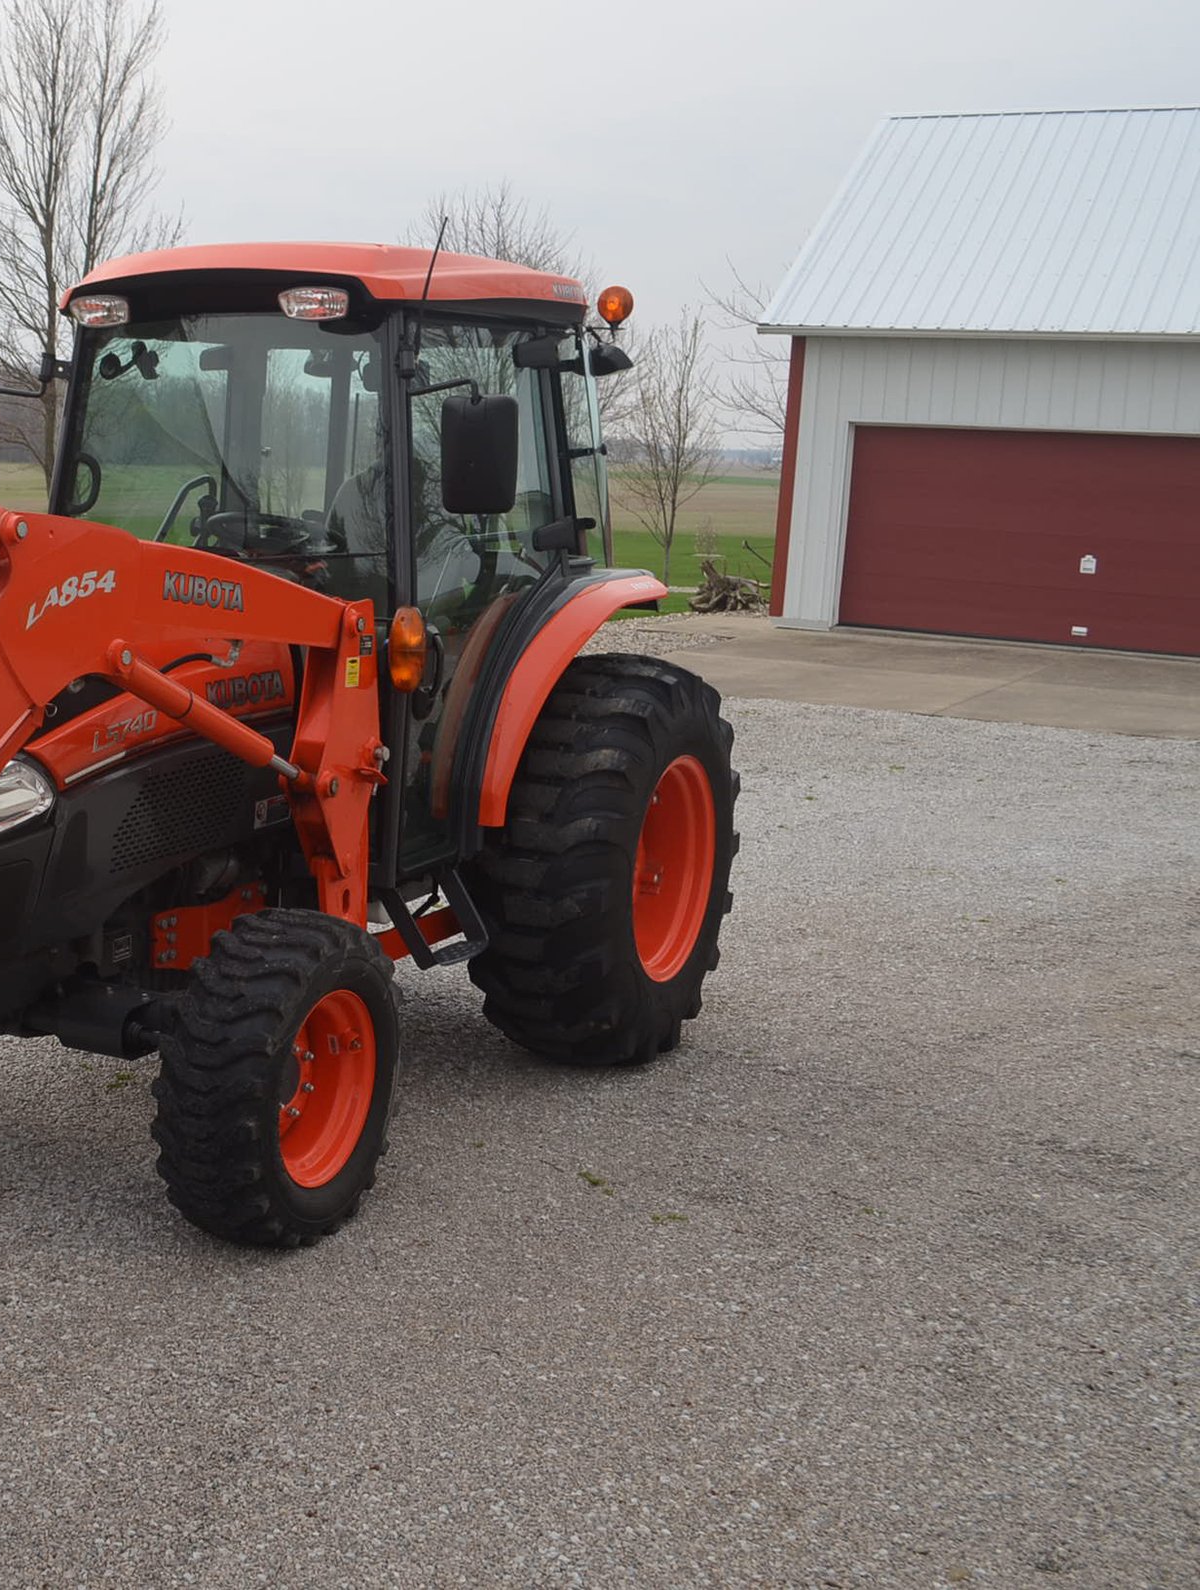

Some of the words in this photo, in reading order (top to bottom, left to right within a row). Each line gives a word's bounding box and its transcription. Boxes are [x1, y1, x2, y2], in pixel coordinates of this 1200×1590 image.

[26, 569, 116, 630] LA854
[163, 570, 243, 612] KUBOTA
[206, 671, 285, 708] KUBOTA
[93, 710, 157, 752] L5740
